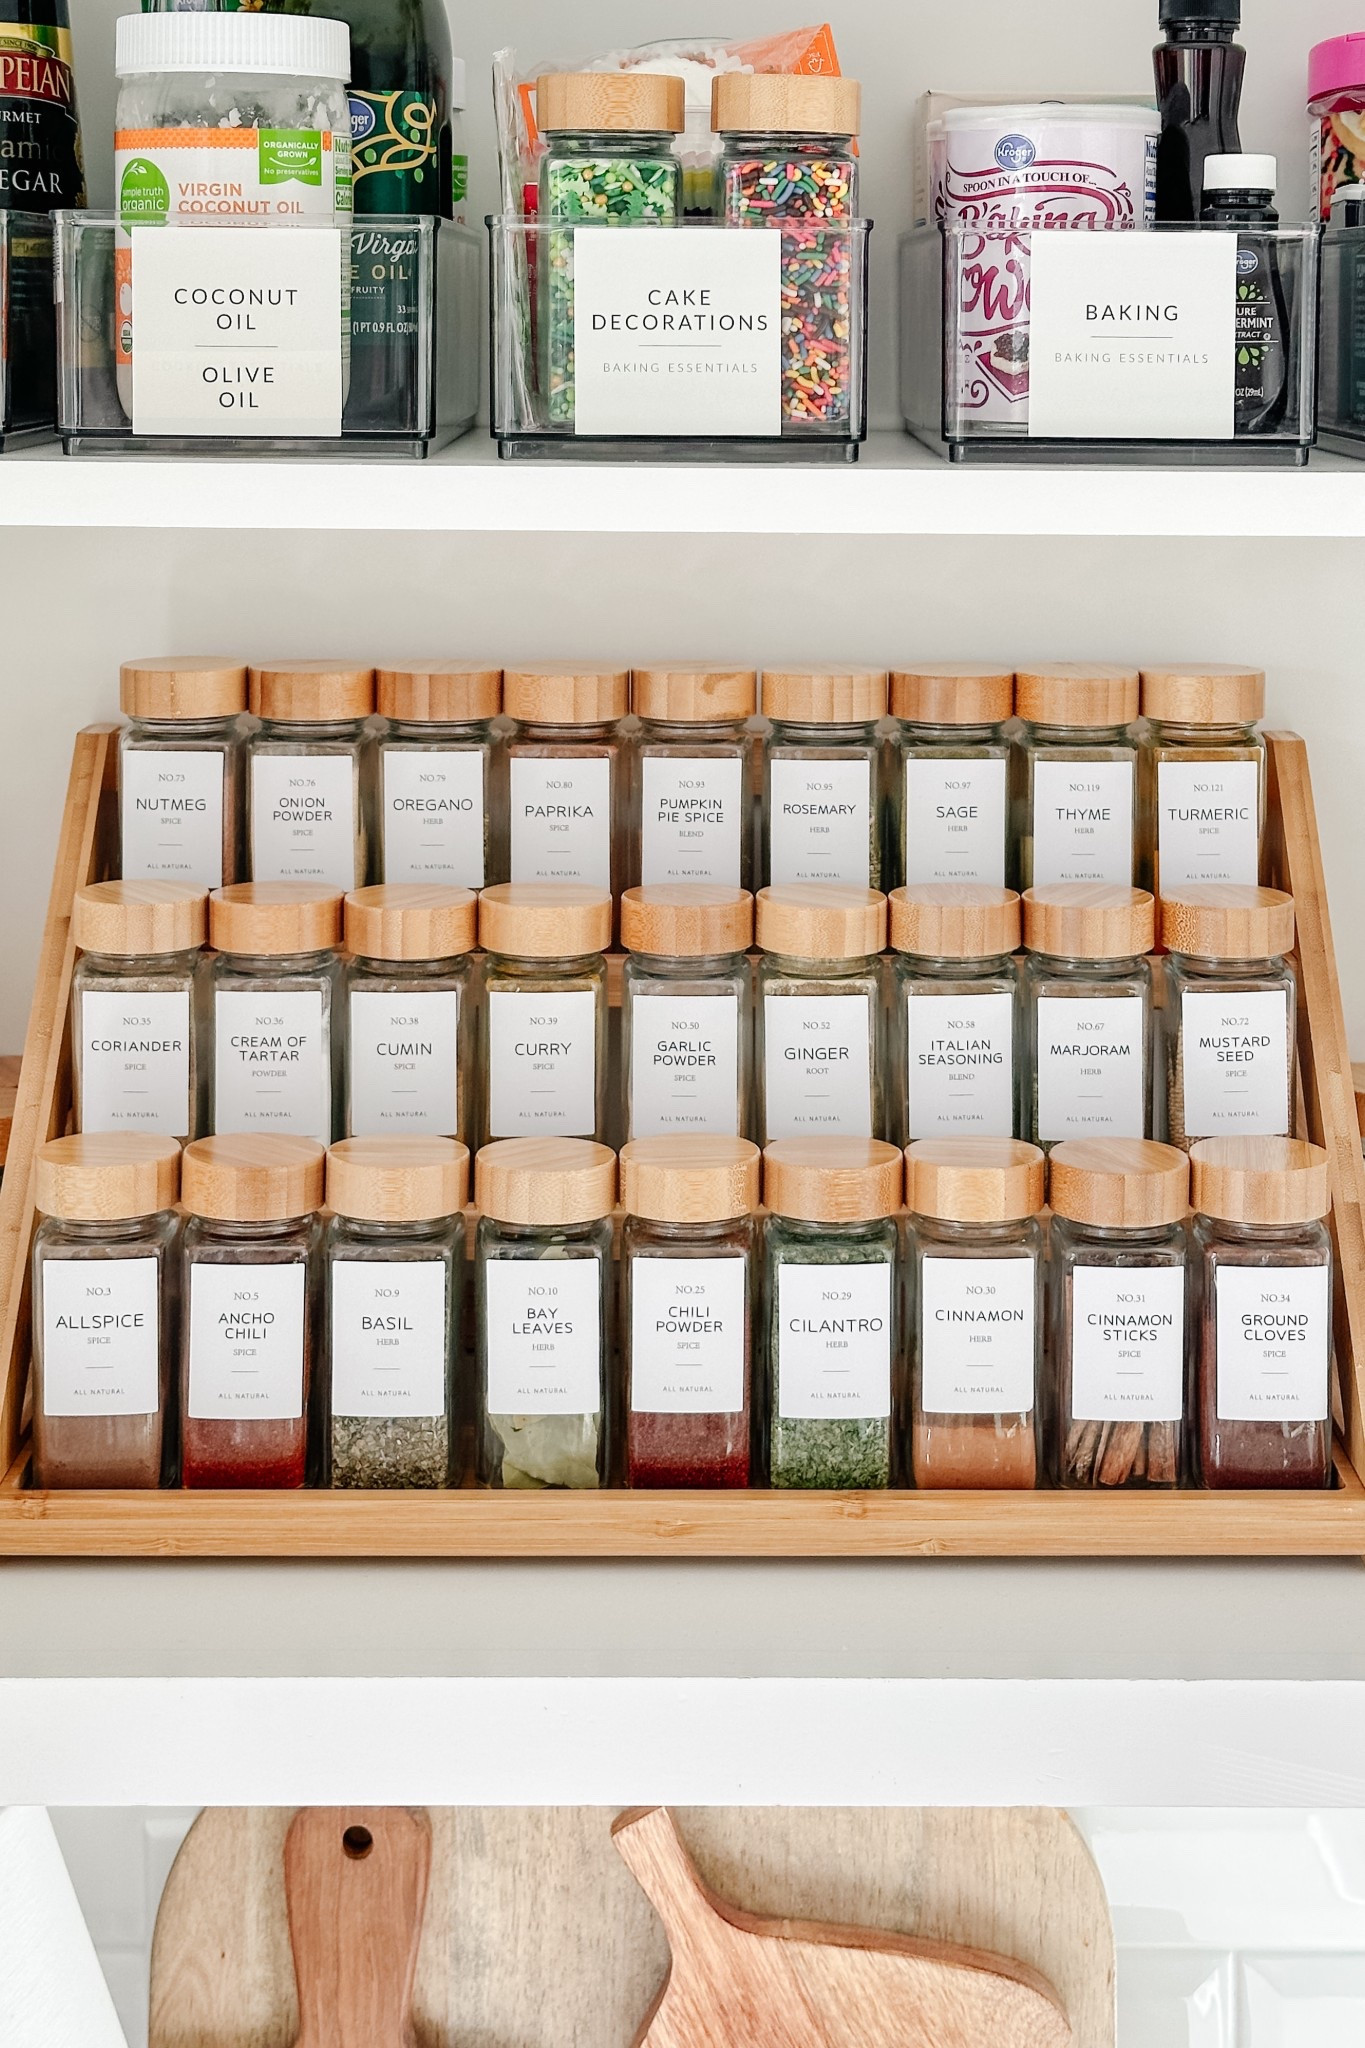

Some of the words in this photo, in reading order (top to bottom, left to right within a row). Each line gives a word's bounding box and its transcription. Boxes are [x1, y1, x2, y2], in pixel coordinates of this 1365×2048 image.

[0, 110, 42, 124] RMET
[263, 141, 319, 150] ORGANICALLY
[277, 150, 308, 158] GROWN
[997, 143, 1033, 162] Kroger
[276, 168, 319, 177] preservatives
[963, 180, 996, 193] SPOON
[998, 176, 1011, 187] IN
[1013, 175, 1020, 183] A
[1023, 172, 1070, 183] TOUCH
[123, 188, 141, 198] simple
[142, 187, 164, 196] truth
[178, 183, 242, 197] VIRGIN
[122, 198, 164, 211] organic
[178, 200, 270, 214] COCONUT
[277, 201, 304, 214] OIL
[1236, 256, 1257, 269] roger
[371, 264, 409, 280] OIL
[174, 287, 298, 306] COCONUT
[647, 289, 711, 306] CAKE
[1085, 304, 1178, 322] BAKING
[216, 313, 257, 331] OIL
[360, 322, 372, 333] PT
[372, 322, 385, 333] 0.9
[386, 322, 396, 333] FL
[592, 313, 768, 332] DECORATIONS
[1235, 331, 1262, 339] TRACT
[1054, 352, 1111, 363] BAKING
[1119, 353, 1209, 364] ESSENTIALS
[603, 362, 660, 373] BAKING
[668, 362, 758, 373] ESSENTIALS
[202, 366, 275, 384] OLIVE
[218, 391, 260, 409] OIL
[158, 773, 186, 783] NO.73
[289, 778, 316, 787] NO.76
[419, 774, 447, 783] NO.79
[545, 780, 573, 789] NO.80
[678, 780, 705, 789] NO.93
[806, 782, 833, 791] NO.95
[944, 781, 971, 790] NO.97
[1069, 783, 1101, 792] NO.119
[1193, 783, 1224, 792] NO.121
[136, 797, 207, 812] NUTMEG
[278, 797, 325, 809] ONION
[392, 798, 474, 812] OREGANO
[660, 798, 723, 810] PUMPKIN
[524, 804, 595, 818] PAPRIKA
[782, 803, 857, 816] ROSEMARY
[935, 805, 979, 819] SAGE
[1054, 807, 1112, 821] THYME
[1167, 807, 1249, 822] TURMERIC
[160, 817, 182, 825] SPICE
[272, 810, 333, 822] POWDER
[422, 817, 444, 825] HERB
[657, 811, 680, 823] PIE
[684, 812, 725, 823] SPICE
[292, 829, 313, 837] SPICE
[549, 824, 570, 832] SPICE
[809, 826, 831, 834] HERB
[947, 824, 968, 832] HERB
[1074, 827, 1095, 835] HERB
[1198, 827, 1220, 835] SPICE
[679, 830, 705, 838] BLEND
[122, 1016, 152, 1026] NO.35
[255, 1016, 284, 1026] NO.36
[390, 1016, 420, 1026] NO.38
[529, 1016, 558, 1026] NO.39
[671, 1021, 700, 1030] NO.50
[802, 1021, 831, 1030] NO.52
[947, 1020, 976, 1029] NO.58
[1076, 1021, 1105, 1031] NO.67
[1220, 1017, 1250, 1027] NO.72
[90, 1039, 182, 1053] CORIANDER
[230, 1035, 282, 1048] CREAM
[286, 1035, 308, 1048] OF
[657, 1040, 712, 1053] GARLIC
[931, 1039, 991, 1052] ITALIAN
[1199, 1035, 1271, 1049] MUSTARD
[376, 1042, 432, 1056] CUMIN
[514, 1041, 572, 1057] CURRY
[783, 1046, 850, 1061] GINGER
[1049, 1044, 1131, 1057] MARJORAM
[238, 1050, 300, 1062] TARTAR
[653, 1054, 717, 1067] POWDER
[918, 1052, 1003, 1066] SEASONING
[1216, 1050, 1255, 1063] SEED
[124, 1063, 146, 1071] SPICE
[393, 1062, 416, 1071] SPICE
[532, 1062, 555, 1071] SPICE
[805, 1067, 830, 1075] ROOT
[1080, 1067, 1102, 1076] HERB
[251, 1069, 287, 1078] POWDER
[673, 1074, 696, 1082] SPICE
[948, 1073, 975, 1081] BLEND
[1225, 1069, 1247, 1078] SPICE
[85, 1286, 112, 1297] NO.3
[374, 1288, 400, 1298] NO.9
[527, 1286, 559, 1296] NO.10
[675, 1284, 706, 1295] NO.25
[965, 1285, 997, 1295] NO.30
[233, 1291, 260, 1301] NO.5
[821, 1291, 852, 1301] NO.29
[1116, 1293, 1146, 1303] NO.31
[1260, 1293, 1291, 1303] NO.34
[526, 1307, 559, 1320] BAY
[668, 1305, 710, 1319] CHILI
[934, 1308, 1024, 1323] CINNAMON
[55, 1313, 145, 1330] ALLSPICE
[217, 1312, 275, 1325] ANCHO
[361, 1316, 414, 1331] BASIL
[1087, 1313, 1173, 1327] CINNAMON
[1240, 1313, 1309, 1327] GROUND
[512, 1321, 573, 1335] LEAVES
[655, 1320, 724, 1333] POWDER
[789, 1317, 884, 1334] CILANTRO
[224, 1327, 267, 1340] CHILI
[969, 1334, 993, 1343] HERB
[1102, 1328, 1158, 1342] STICKS
[1243, 1328, 1306, 1342] CLOVES
[87, 1336, 112, 1345] SPICE
[376, 1338, 400, 1346] HERB
[676, 1341, 701, 1350] SPICE
[825, 1340, 849, 1349] HERB
[232, 1348, 257, 1357] SPICE
[531, 1343, 555, 1352] HERB
[1117, 1350, 1142, 1358] SPICE
[1262, 1350, 1287, 1358] SPICE
[1249, 1393, 1264, 1401] ALL
[1265, 1393, 1300, 1401] NATURAL
